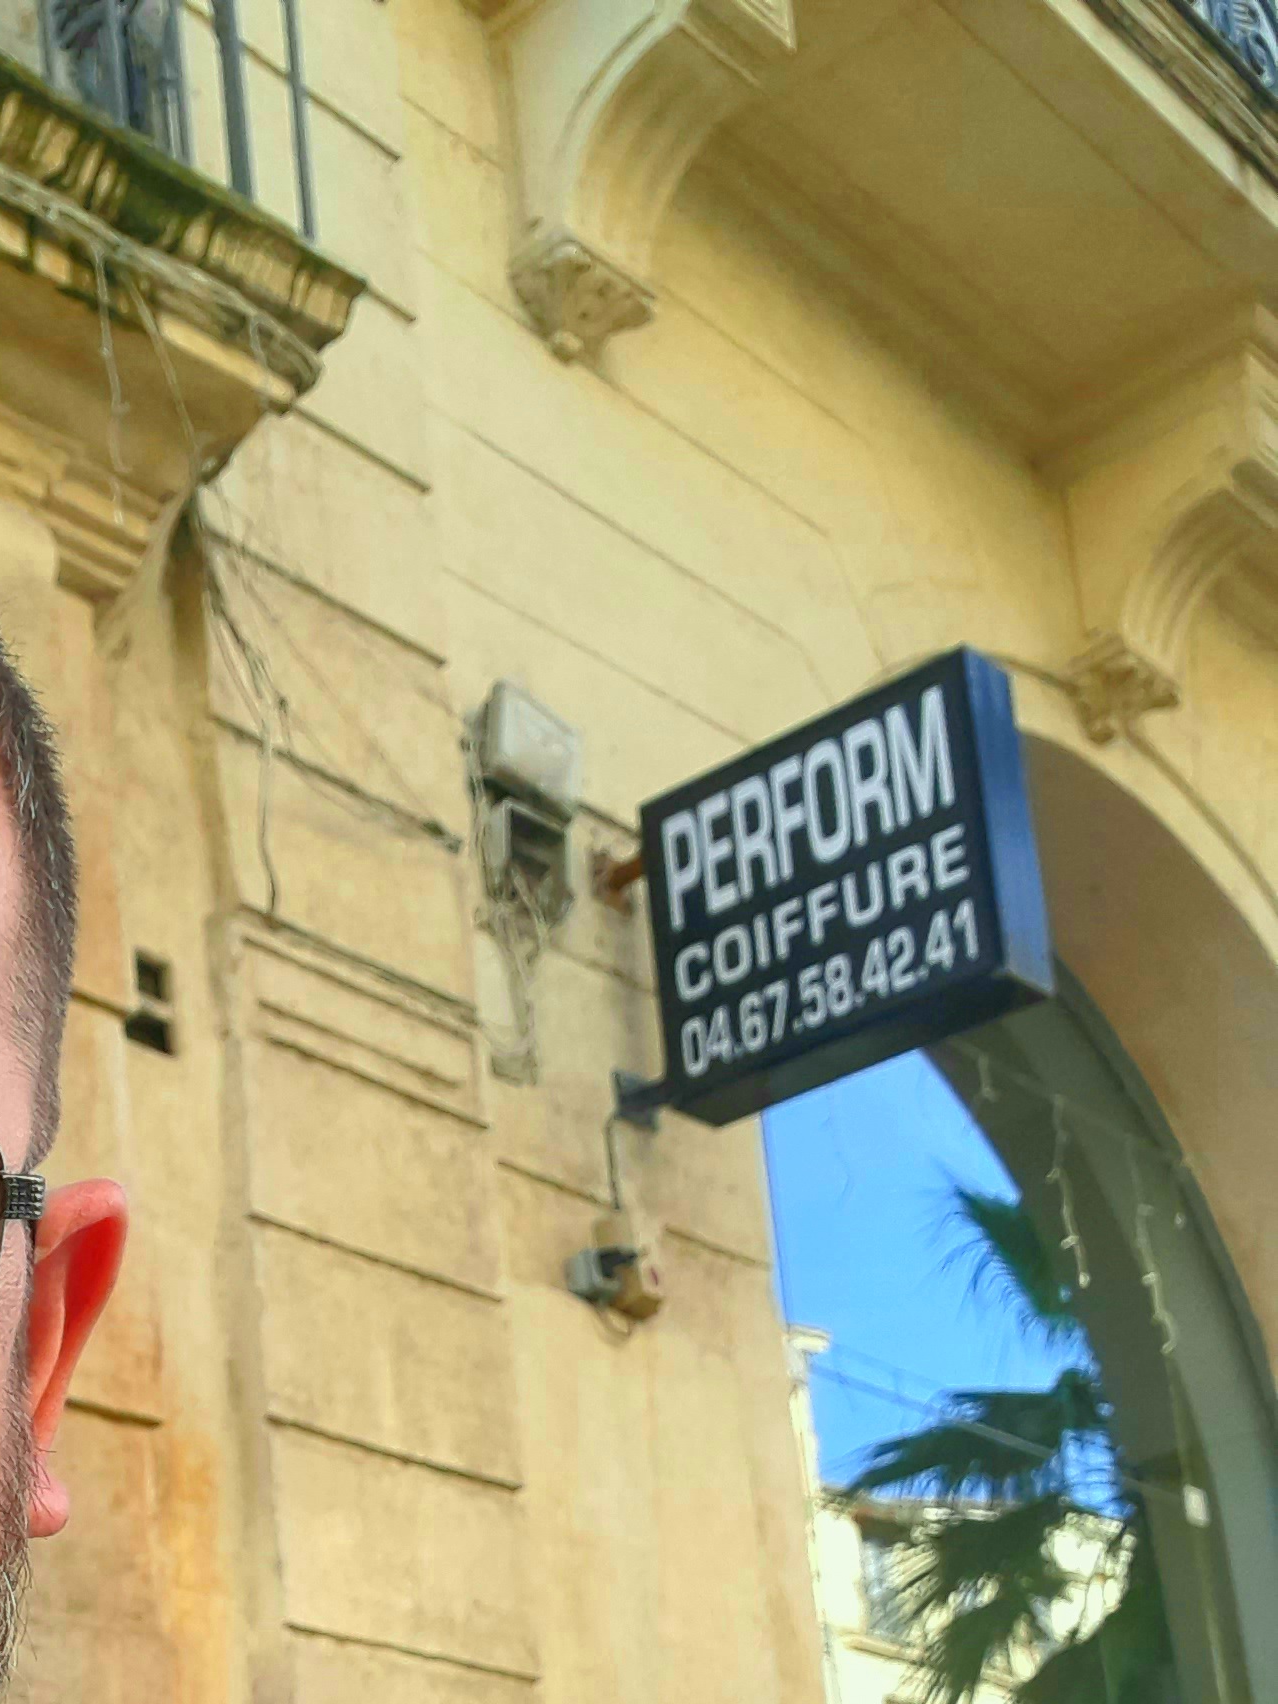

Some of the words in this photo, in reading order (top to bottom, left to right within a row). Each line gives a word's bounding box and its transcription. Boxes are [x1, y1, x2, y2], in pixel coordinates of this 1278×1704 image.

[661, 685, 955, 931] PERFORM
[675, 823, 971, 1001] COIFFURE
[681, 898, 980, 1076] 04.67.58.42.41
